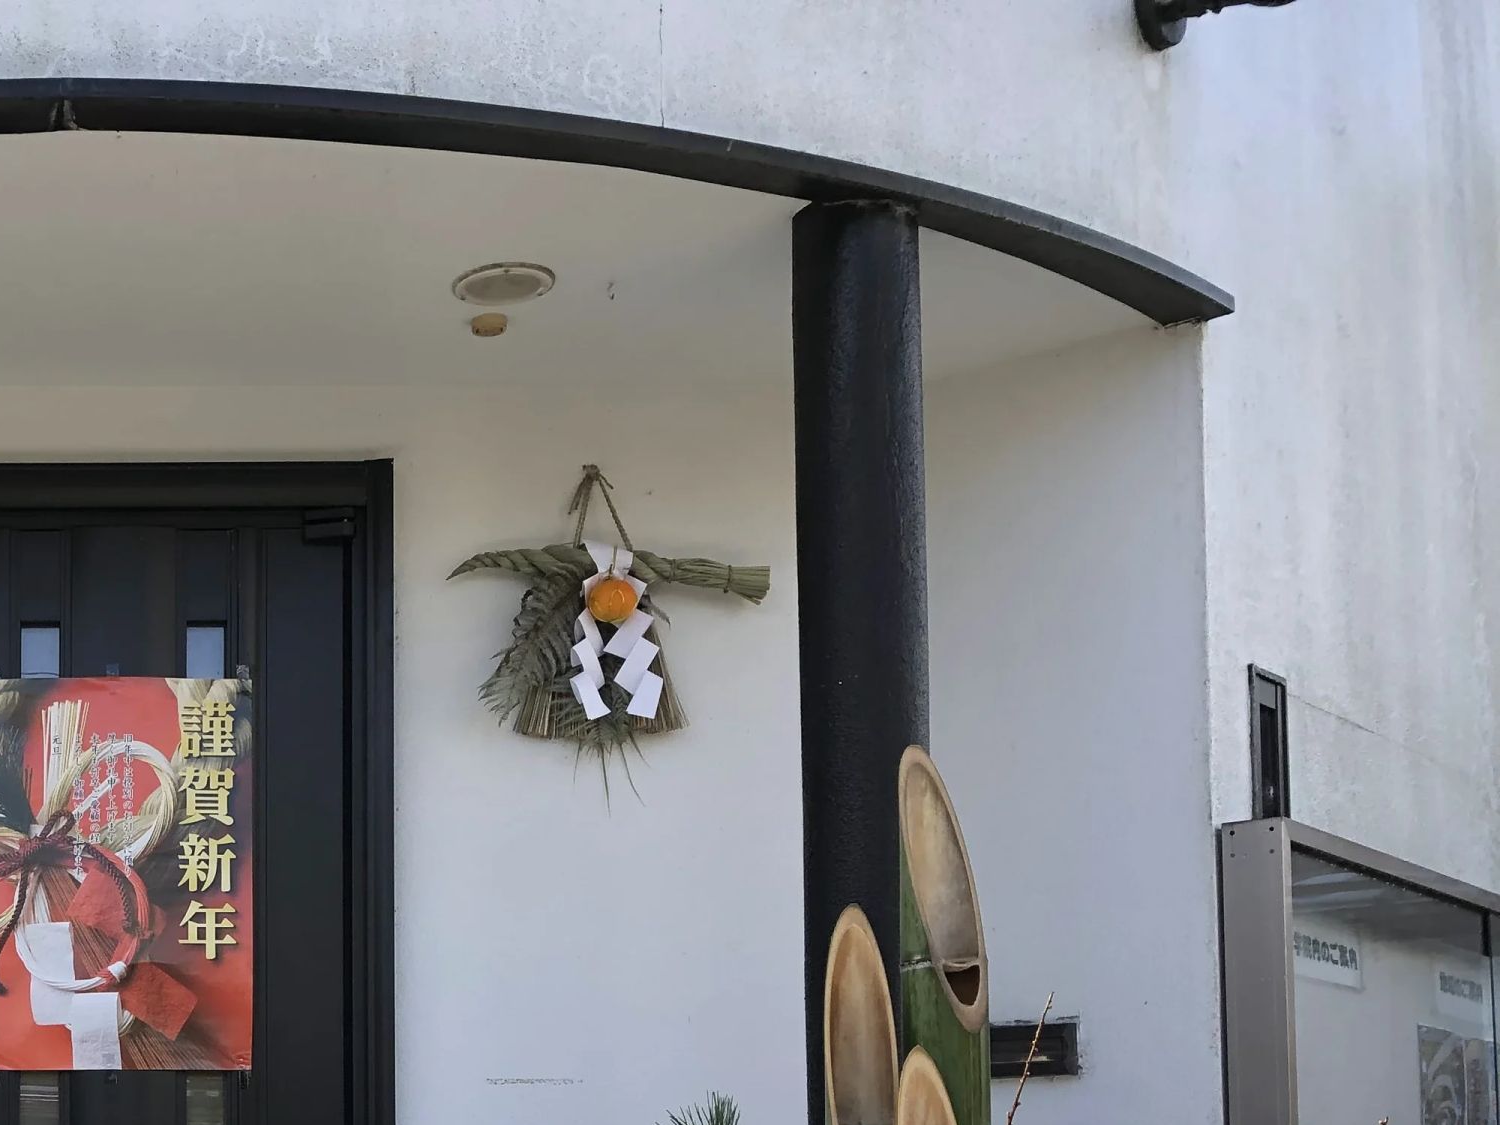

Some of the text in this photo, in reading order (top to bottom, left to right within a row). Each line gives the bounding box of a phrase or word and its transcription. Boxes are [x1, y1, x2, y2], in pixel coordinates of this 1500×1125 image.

[52, 734, 62, 755] 元旦
[178, 702, 236, 960] 謹賀新年
